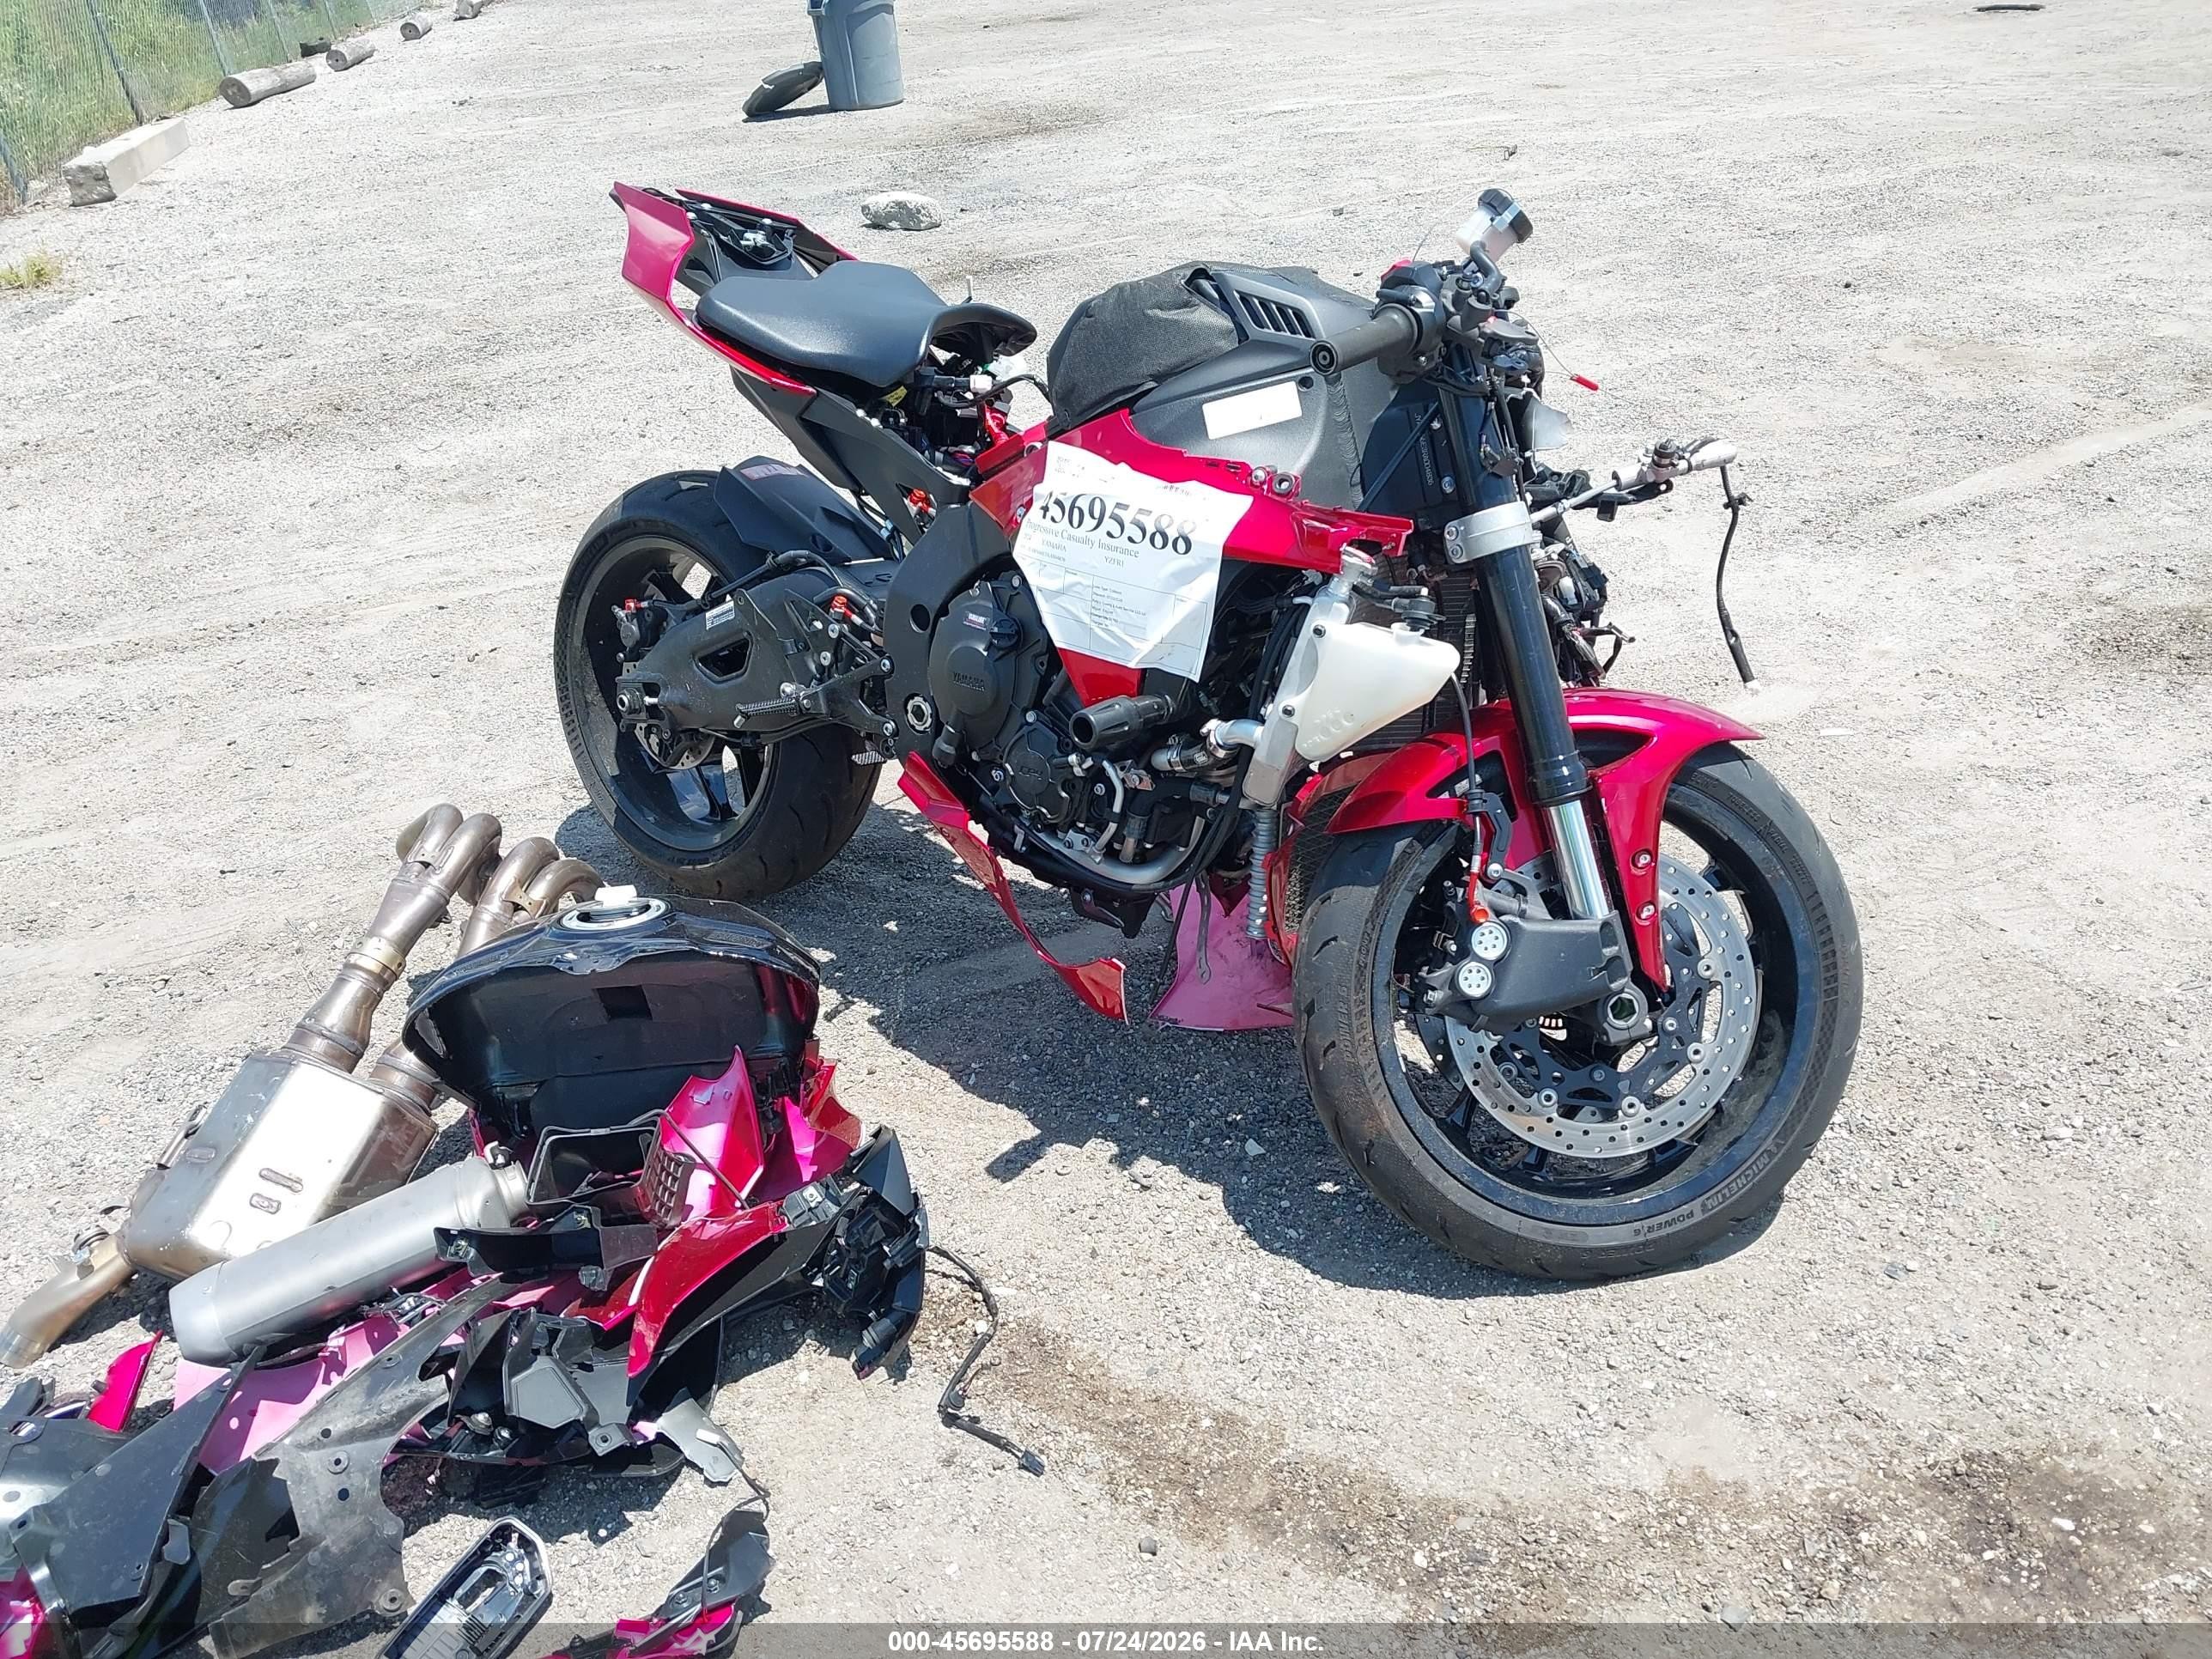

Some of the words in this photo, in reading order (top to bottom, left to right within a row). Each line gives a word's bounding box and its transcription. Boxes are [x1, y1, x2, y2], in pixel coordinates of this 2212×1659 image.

[1040, 491, 1196, 556] 45695588
[1060, 529, 1096, 549] Casualty
[1098, 538, 1139, 558] Insurance
[1706, 1154, 1771, 1210] MICHELIN
[1647, 1210, 1695, 1234] POWER
